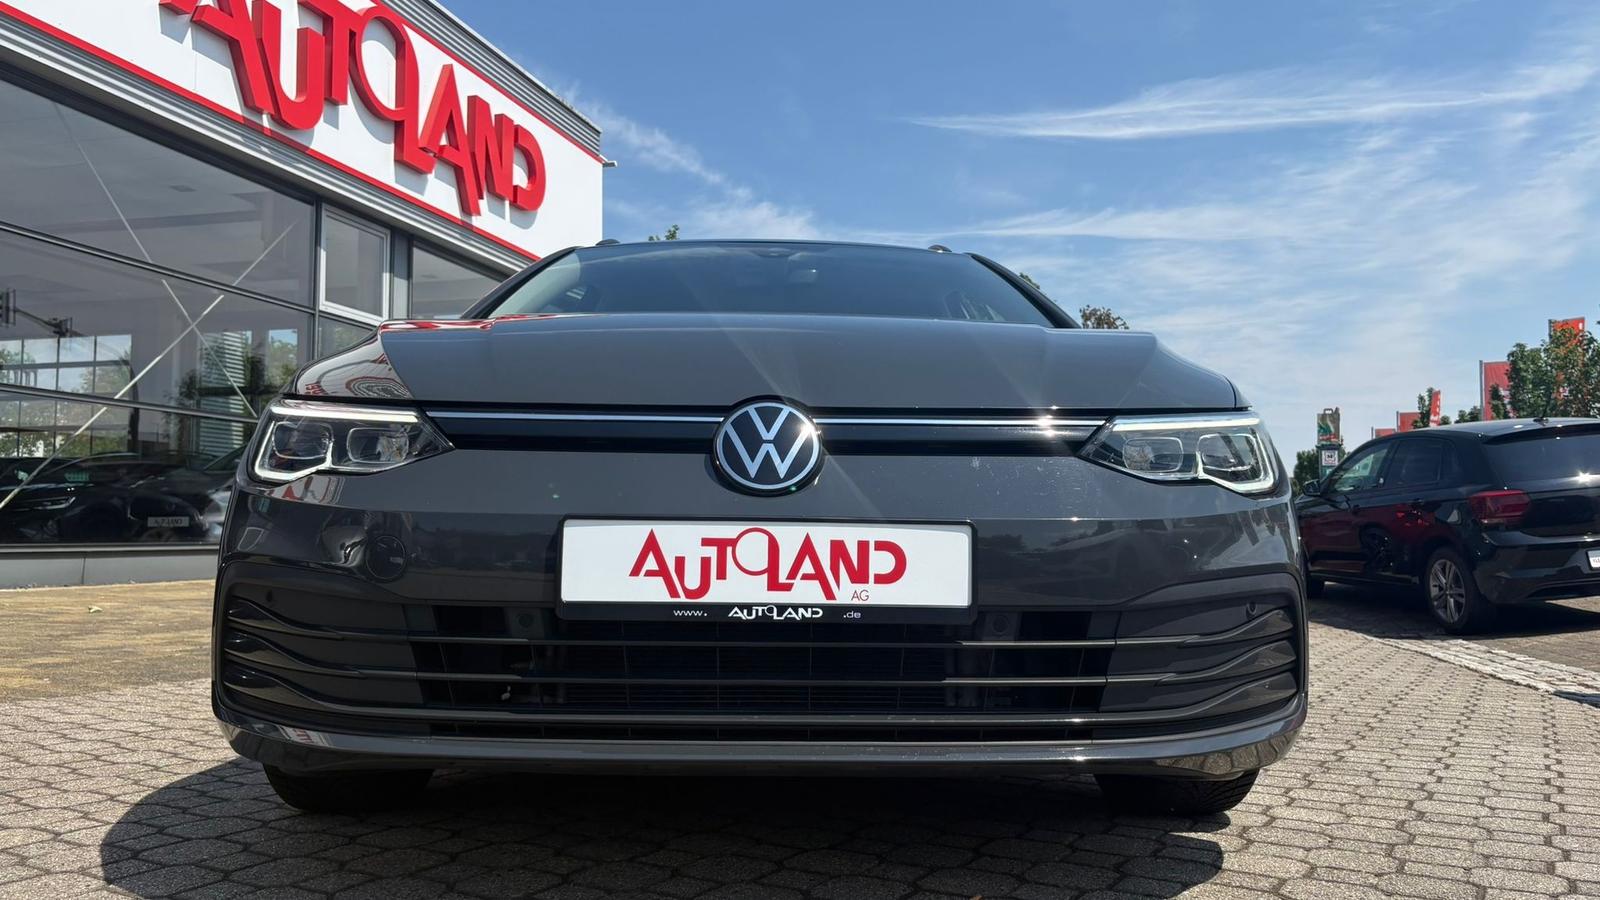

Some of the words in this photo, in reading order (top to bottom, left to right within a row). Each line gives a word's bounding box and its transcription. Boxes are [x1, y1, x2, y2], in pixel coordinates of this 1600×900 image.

[724, 405, 814, 480] VW
[629, 527, 907, 601] AUTOLAND
[728, 605, 823, 621] AUTOLAND
[843, 610, 861, 619] .de
[851, 590, 869, 602] AG
